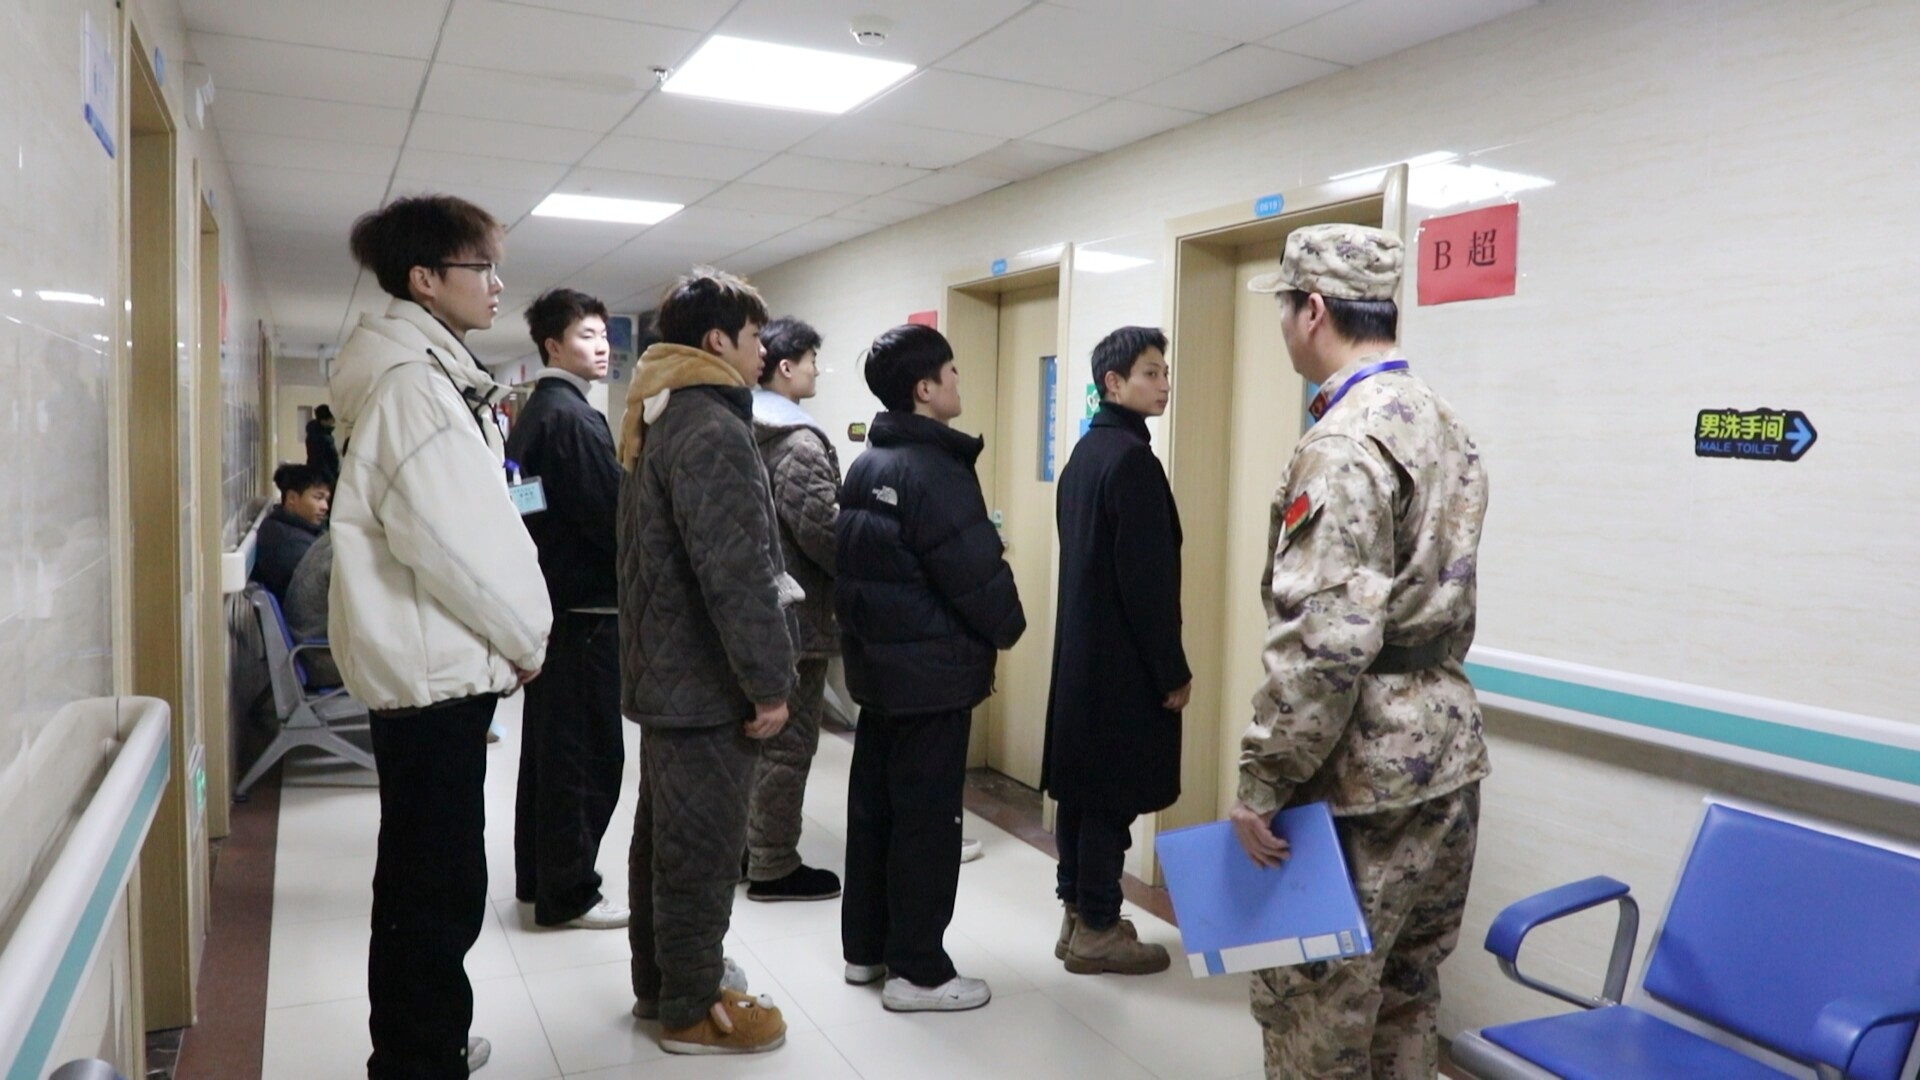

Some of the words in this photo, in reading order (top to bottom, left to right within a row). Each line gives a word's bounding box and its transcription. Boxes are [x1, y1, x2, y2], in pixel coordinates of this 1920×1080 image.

[1433, 239, 1452, 272] B
[1467, 228, 1497, 267] 超
[1699, 413, 1784, 440] 男洗手间
[1700, 442, 1731, 452] MALE
[1737, 443, 1778, 454] TOILET
